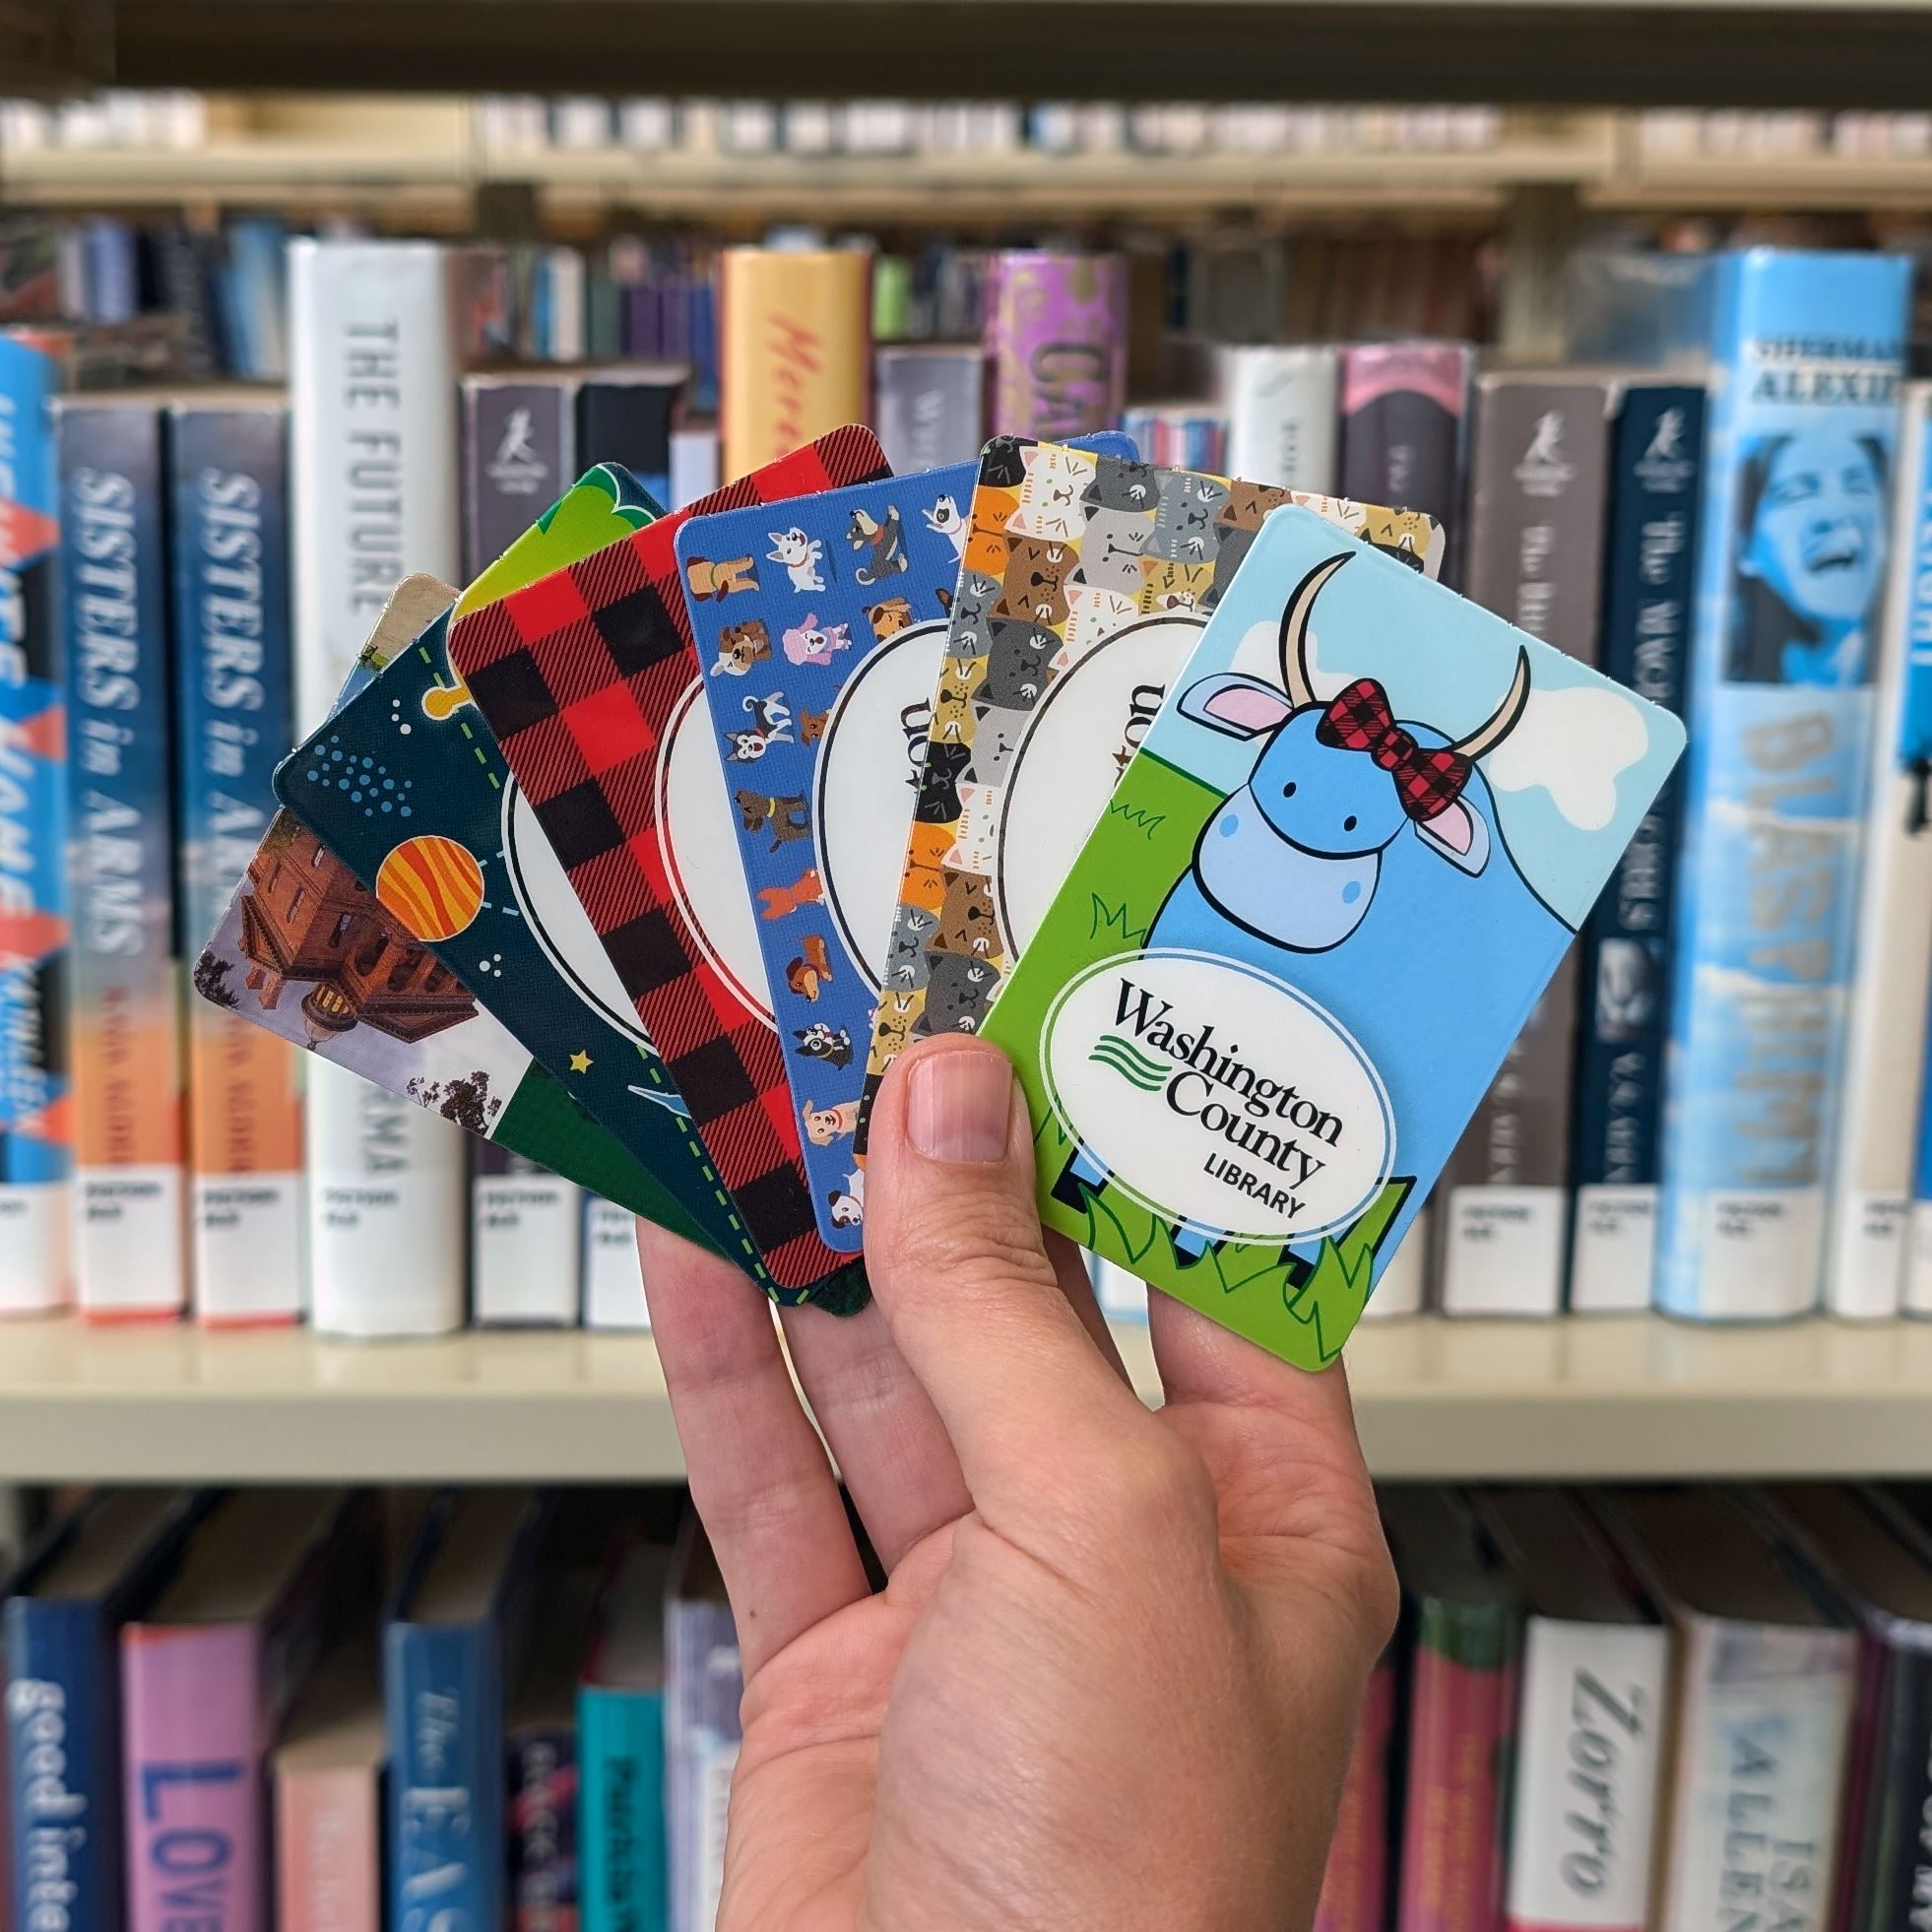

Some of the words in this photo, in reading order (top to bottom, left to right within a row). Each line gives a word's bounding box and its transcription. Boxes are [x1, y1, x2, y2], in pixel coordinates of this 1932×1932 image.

[346, 321, 400, 409] THE
[75, 466, 139, 711] SISTERS
[200, 466, 265, 711] SISTERS
[349, 428, 403, 616] FUTURE
[82, 718, 134, 776] in
[206, 719, 259, 776] in
[84, 789, 144, 956] ARMS
[1113, 978, 1343, 1148] Washington
[1166, 1070, 1325, 1190] County
[1204, 1153, 1307, 1219] LIBRARY
[6, 1678, 88, 1815] good
[1560, 1666, 1645, 1899] Zorro
